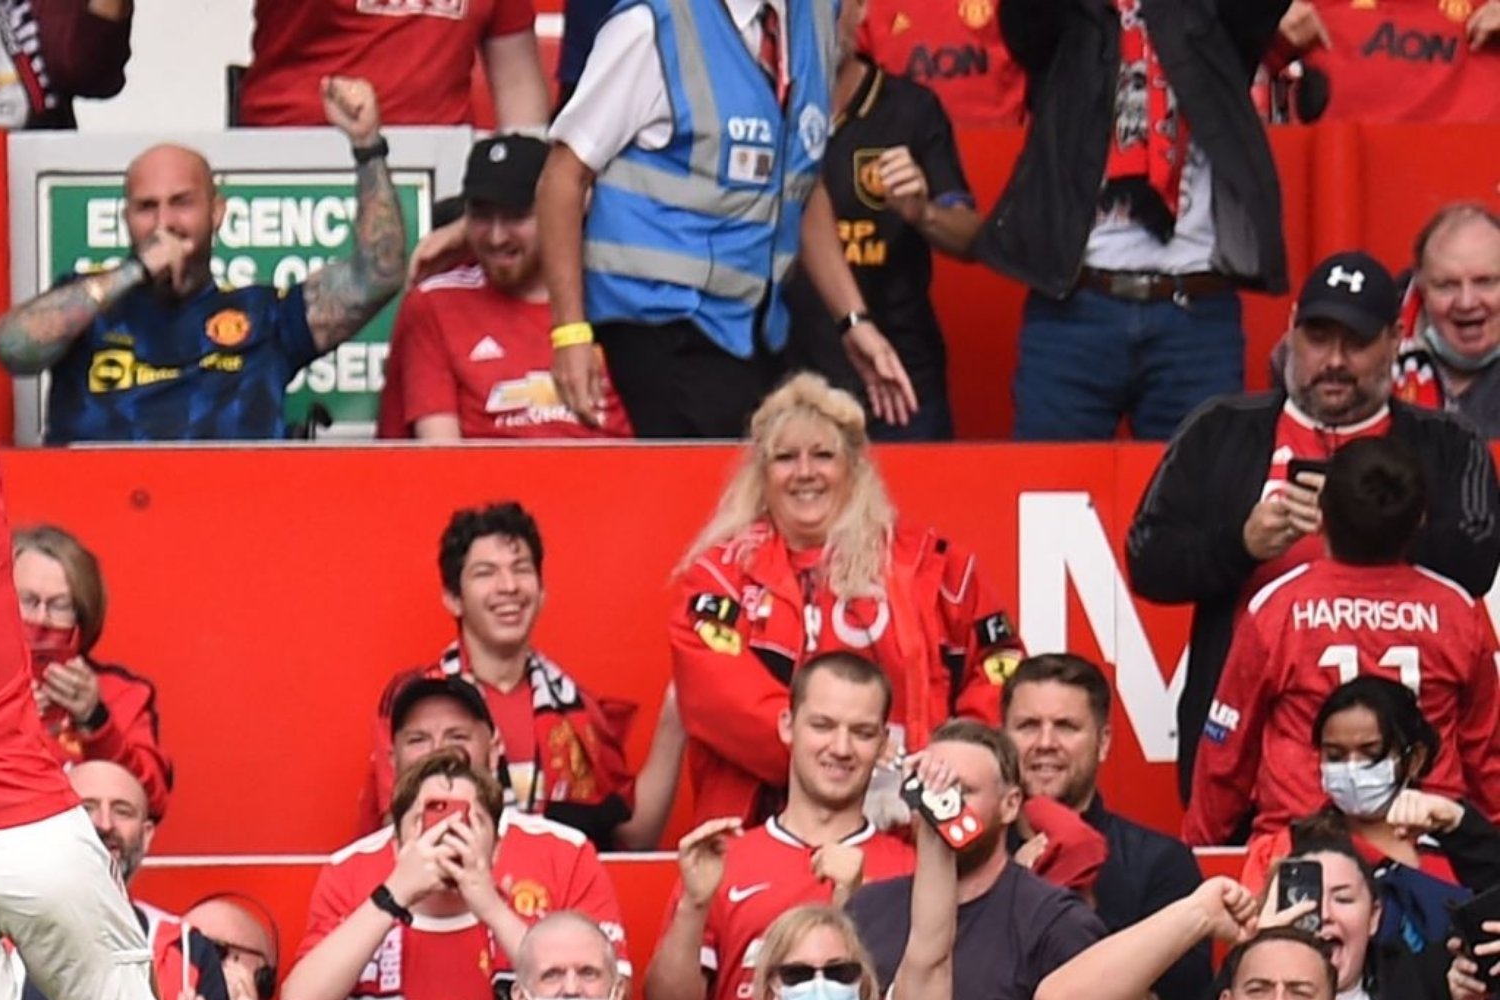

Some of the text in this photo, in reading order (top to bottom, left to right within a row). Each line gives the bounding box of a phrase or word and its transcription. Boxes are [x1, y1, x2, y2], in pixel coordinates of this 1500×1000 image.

[906, 43, 990, 79] AON
[1361, 21, 1458, 65] AON
[87, 197, 358, 248] EGENC
[1293, 598, 1439, 633] HARRISON
